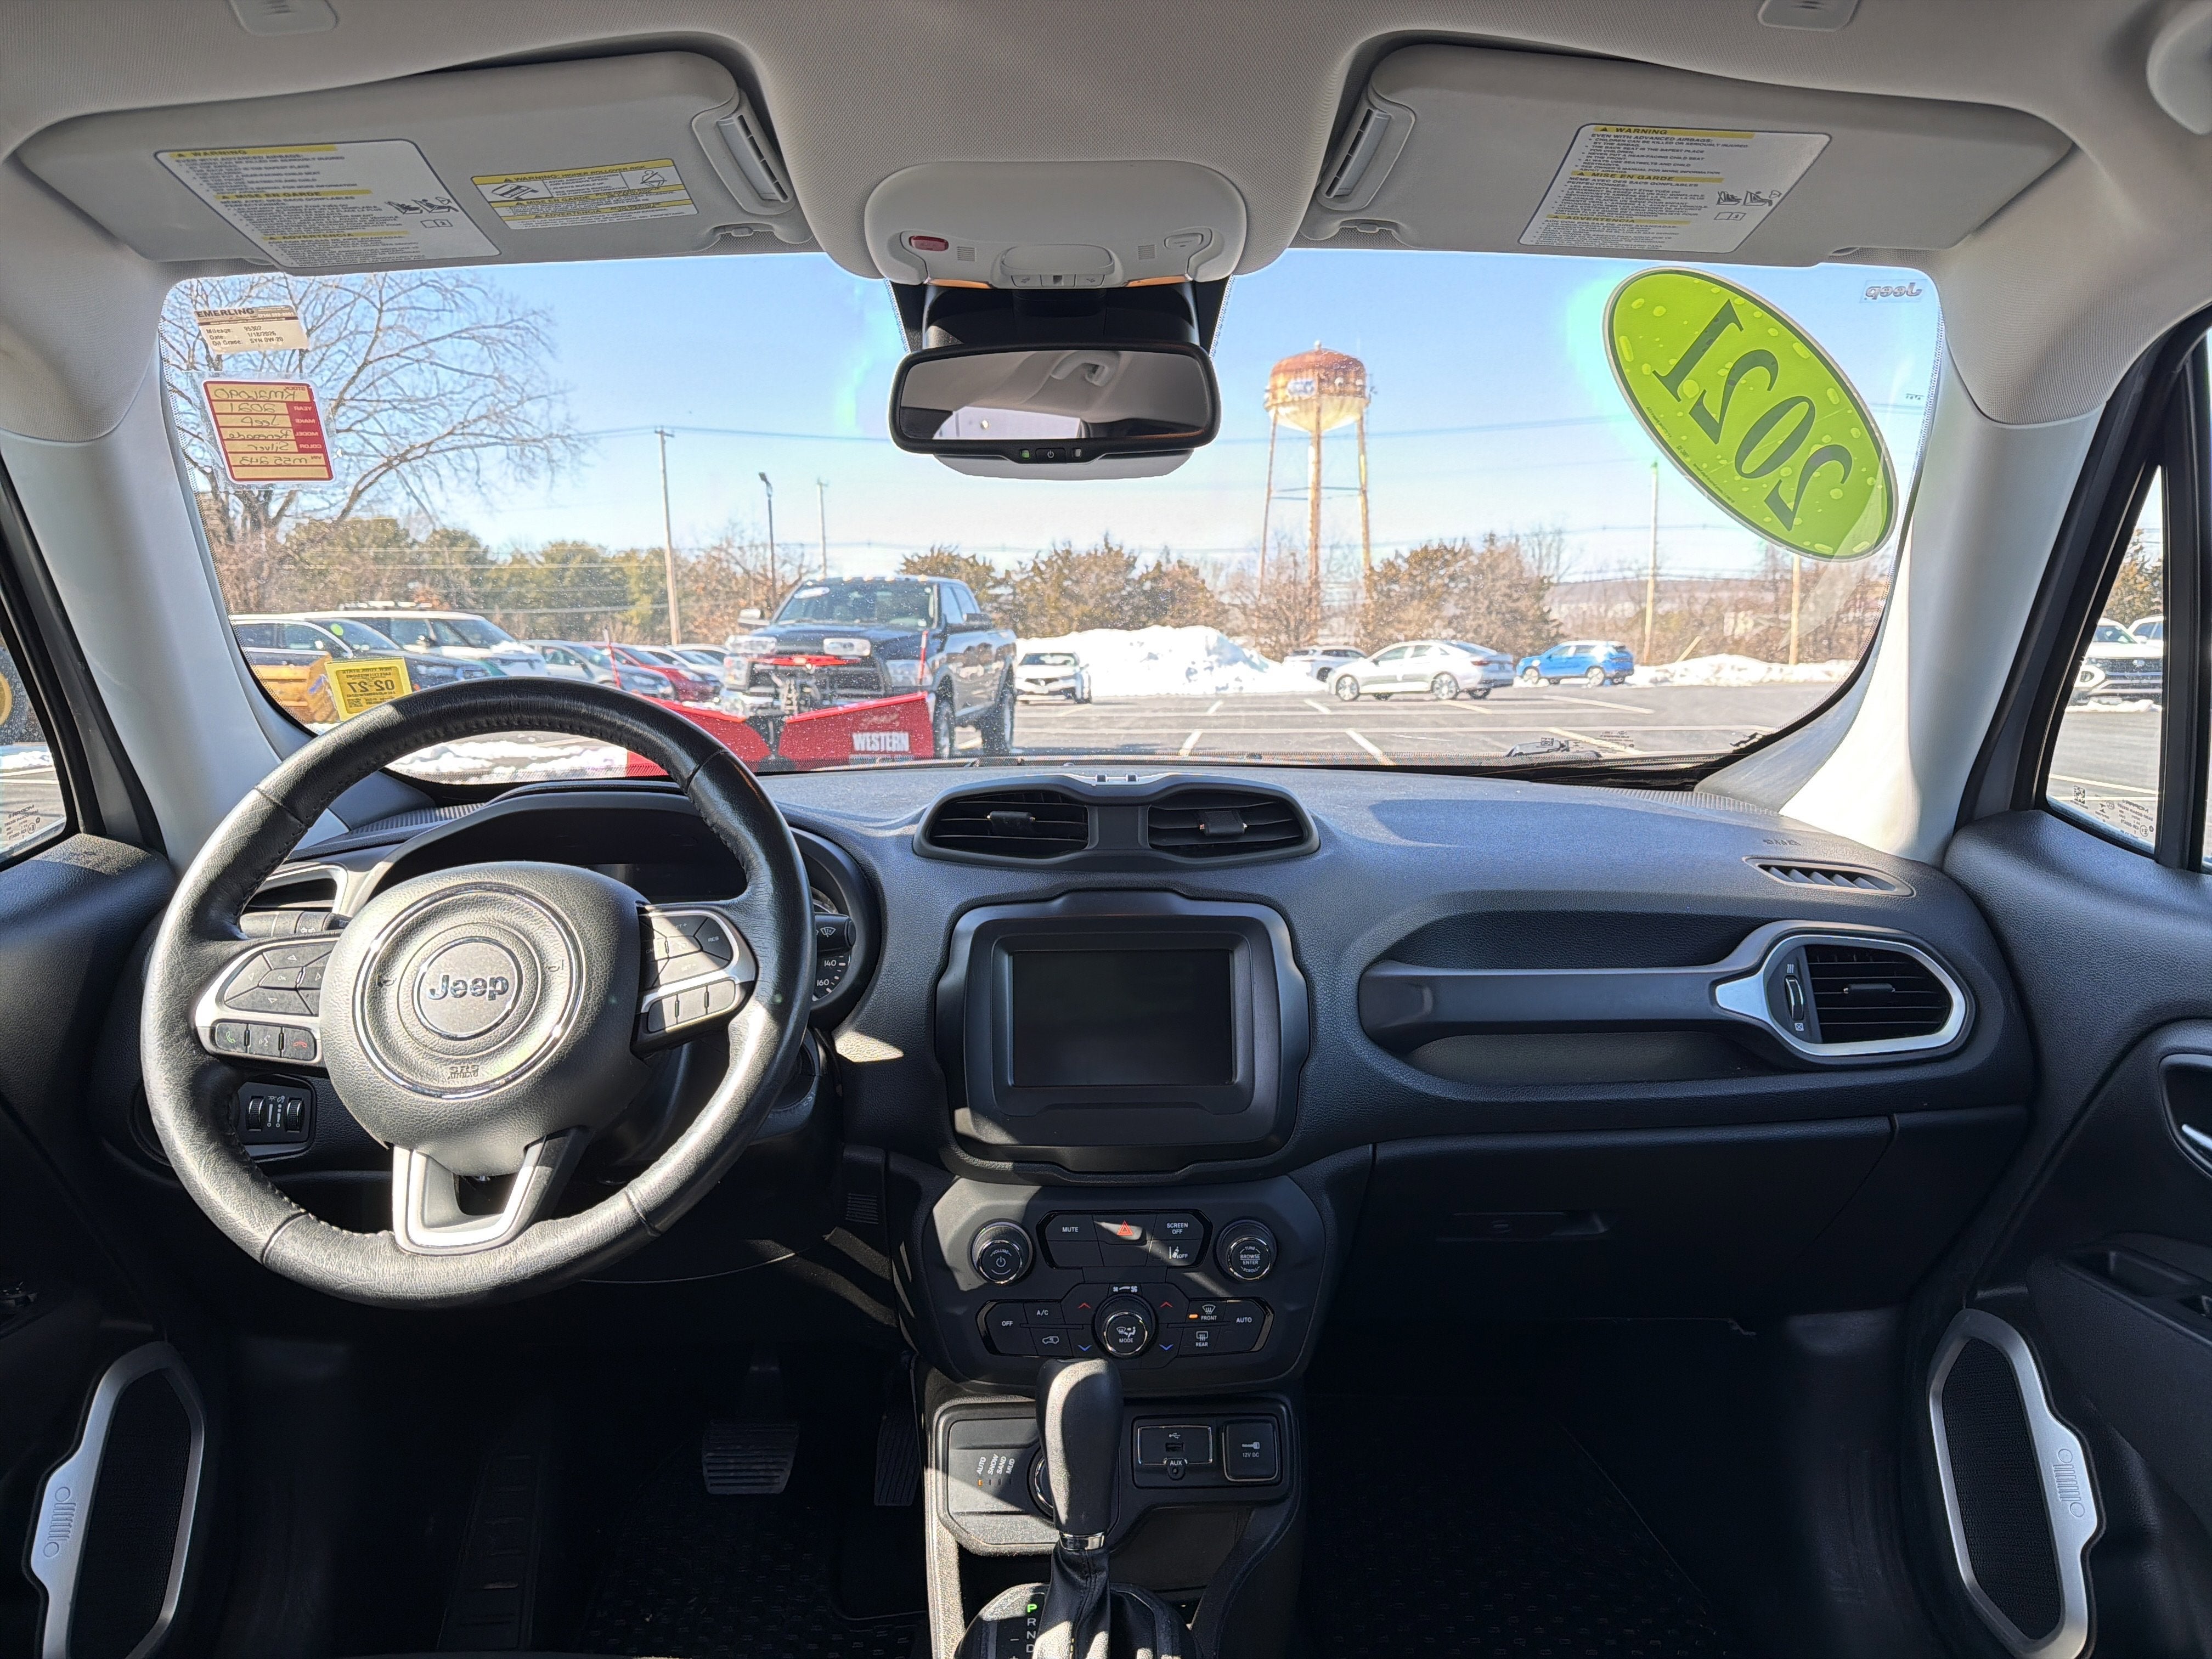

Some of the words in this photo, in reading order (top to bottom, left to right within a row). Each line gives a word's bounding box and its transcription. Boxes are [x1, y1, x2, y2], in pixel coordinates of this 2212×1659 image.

[196, 308, 255, 318] EMERLING
[853, 731, 909, 752] WESTERN
[427, 974, 509, 1001] Jeep
[449, 1064, 479, 1073] SRS
[977, 1457, 986, 1475] AUTO
[988, 1453, 998, 1475] SNOW
[996, 1456, 1007, 1474] SAND
[1006, 1458, 1015, 1474] MUD
[1028, 1604, 1037, 1612] P
[1027, 1618, 1036, 1626] R
[1026, 1630, 1036, 1639] N
